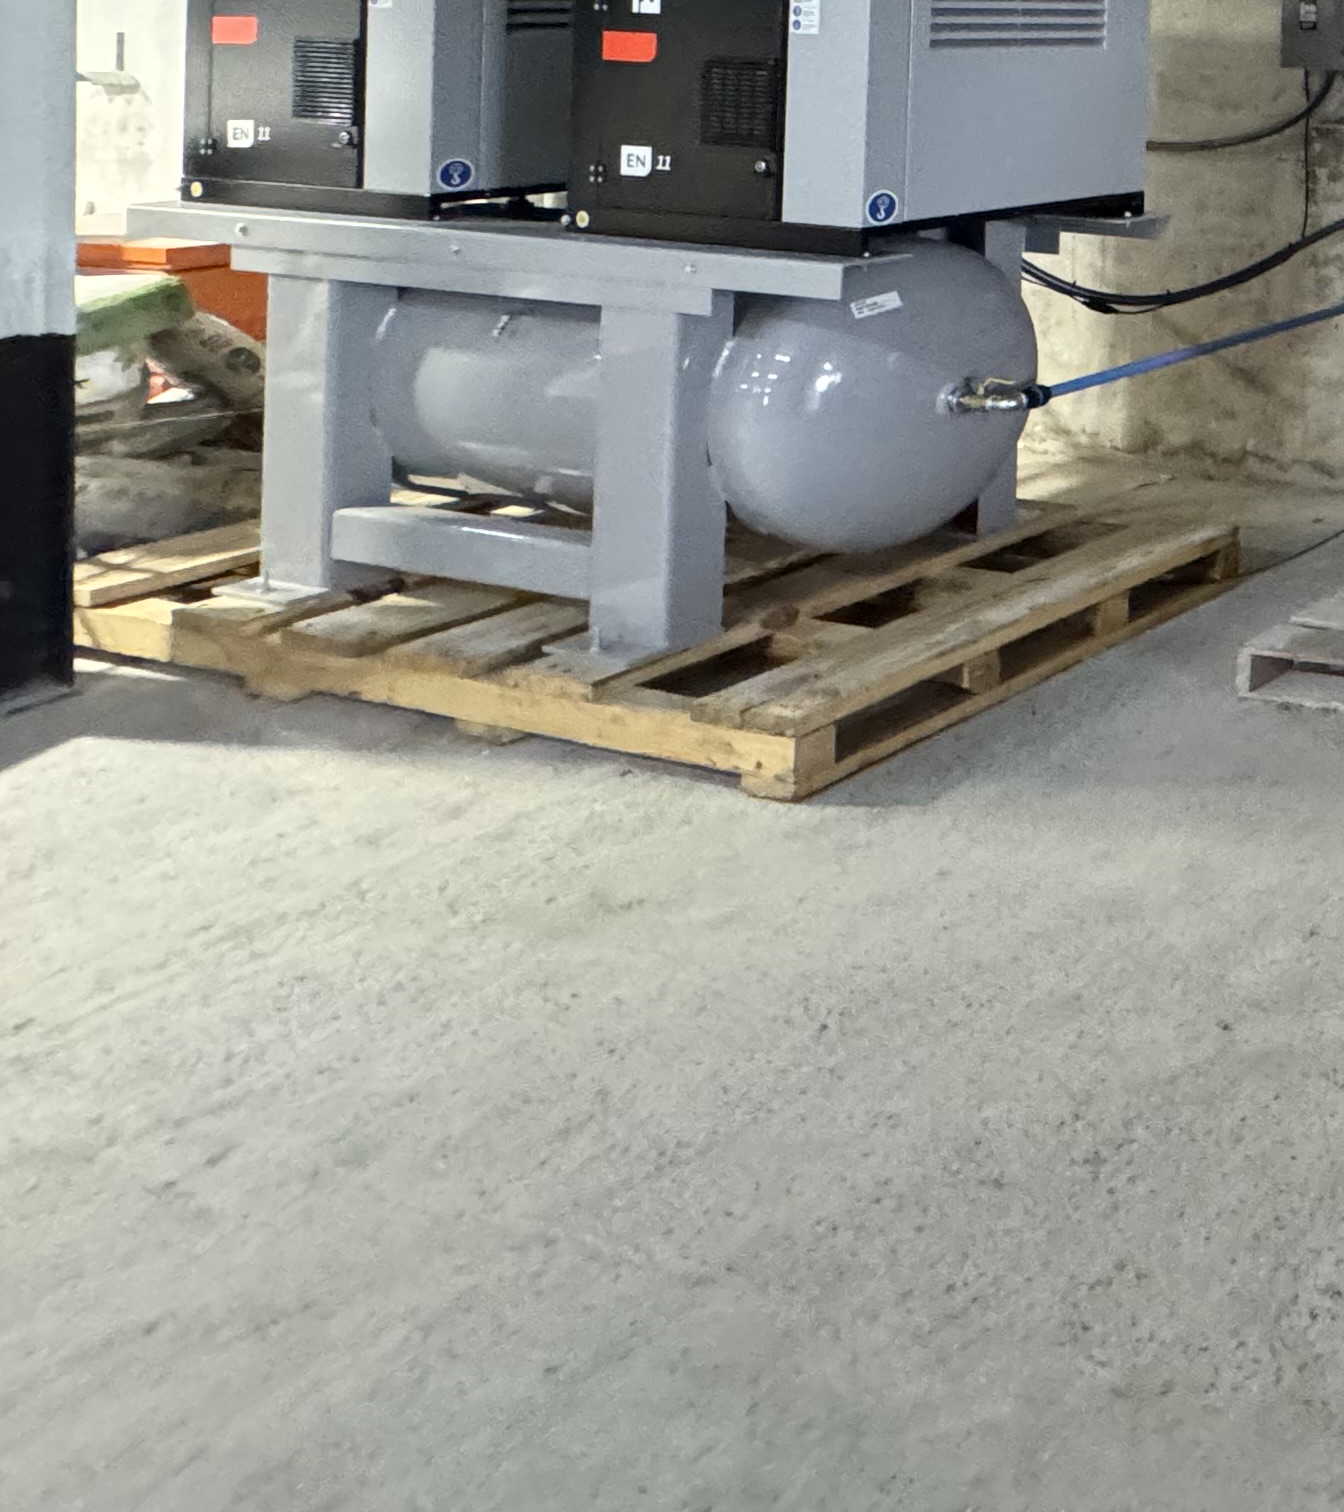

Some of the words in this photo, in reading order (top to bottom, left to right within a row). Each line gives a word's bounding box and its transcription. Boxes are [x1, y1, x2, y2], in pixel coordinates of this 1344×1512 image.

[232, 127, 249, 140] EN
[257, 126, 271, 141] 11
[627, 153, 646, 168] EN
[655, 155, 671, 171] 11
